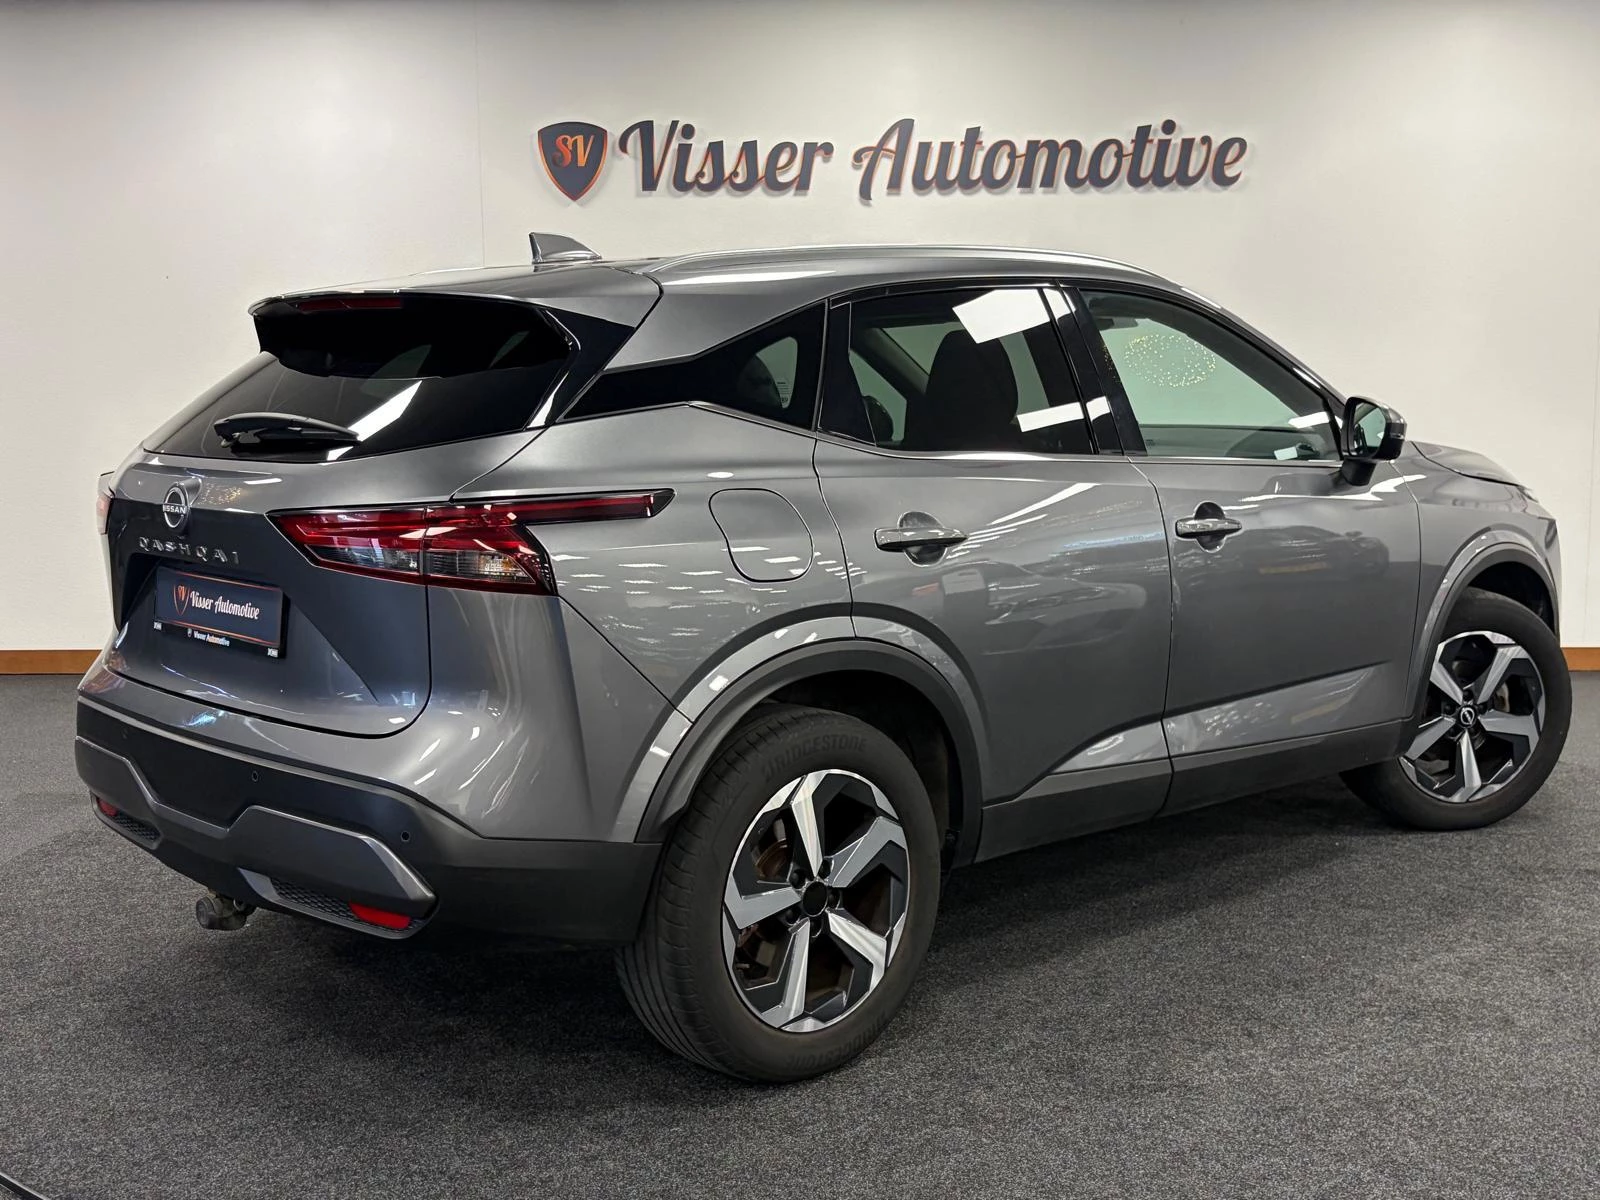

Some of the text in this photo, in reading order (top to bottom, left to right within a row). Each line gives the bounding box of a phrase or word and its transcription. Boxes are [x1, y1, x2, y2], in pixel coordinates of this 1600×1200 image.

[553, 134, 595, 168] SV
[618, 118, 1248, 201] Visser Automotive
[162, 504, 187, 514] SSAN
[138, 537, 240, 564] QASHQAI
[190, 590, 260, 620] Visser Automotive
